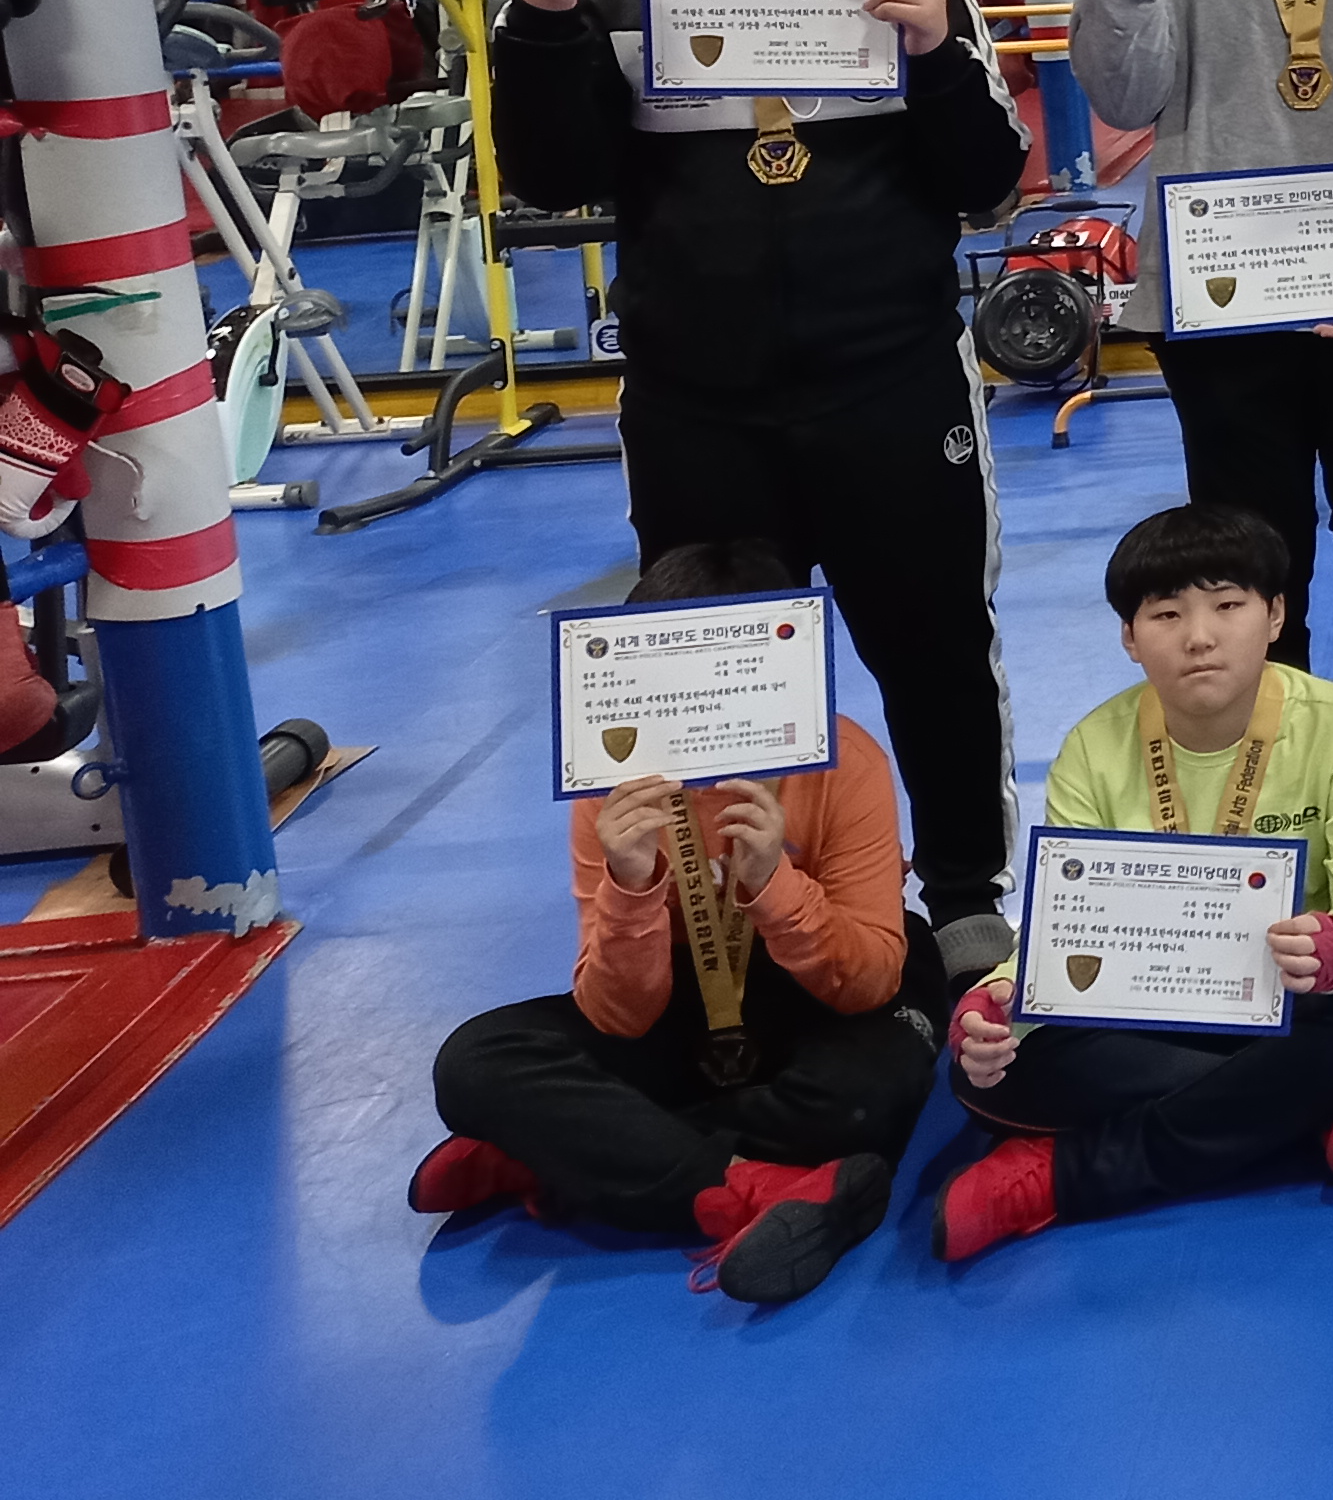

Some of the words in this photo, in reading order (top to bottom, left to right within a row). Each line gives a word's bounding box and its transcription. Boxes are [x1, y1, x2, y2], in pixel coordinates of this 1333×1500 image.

[1213, 196, 1236, 209] 세계
[613, 633, 640, 649] 세계
[1089, 861, 1116, 875] 세계
